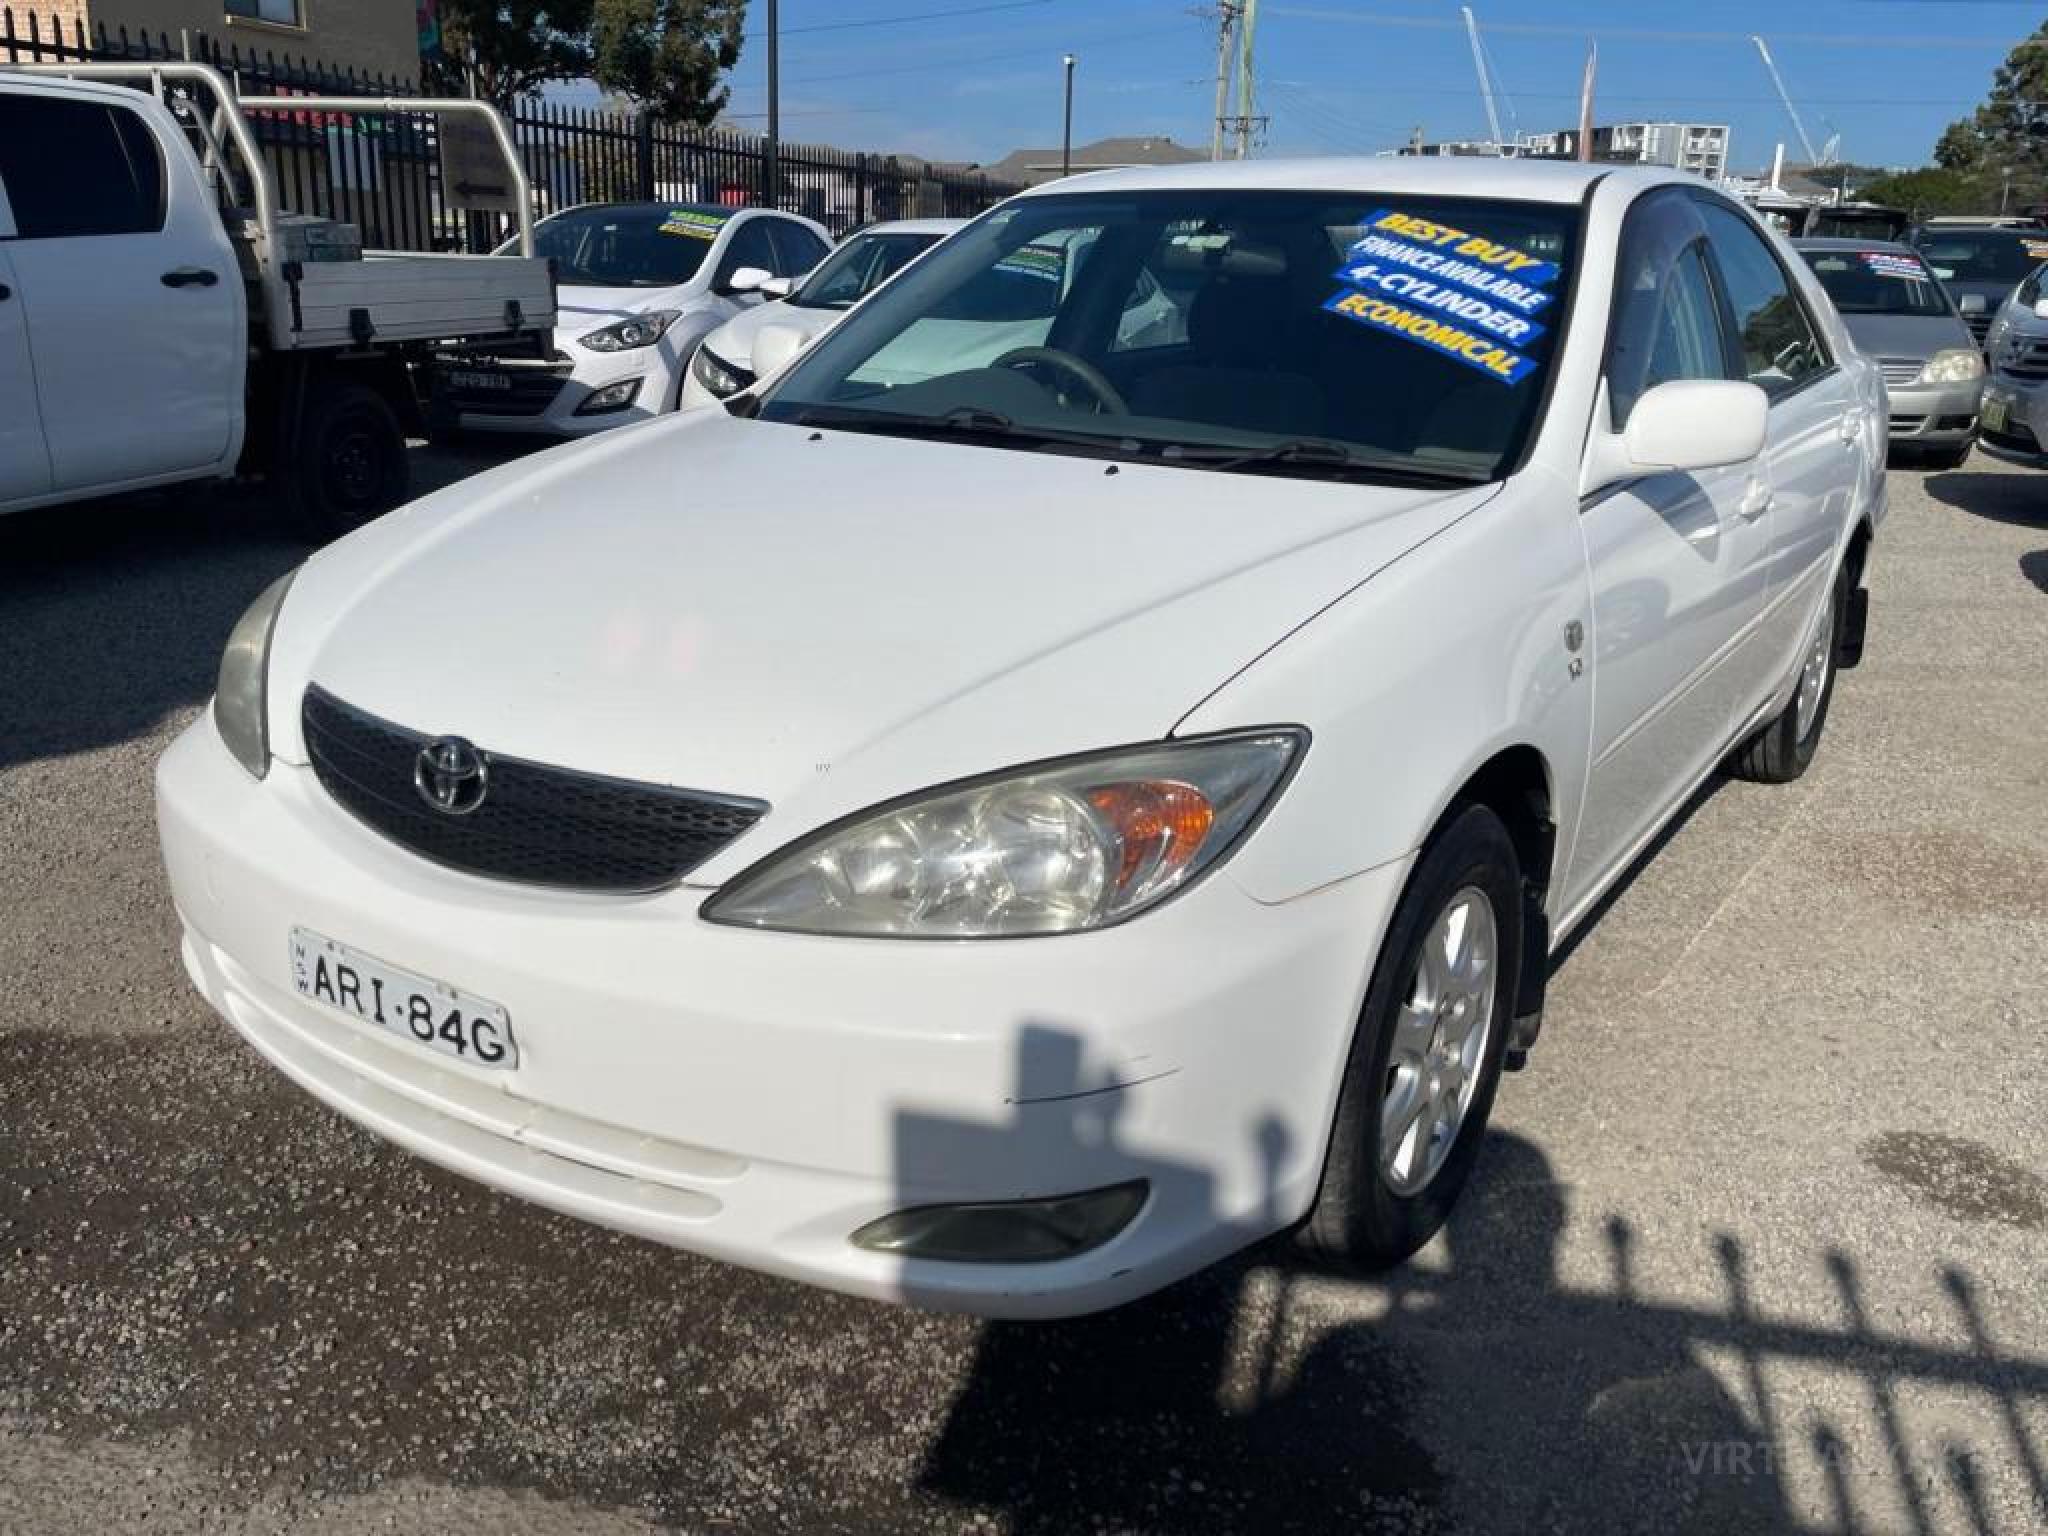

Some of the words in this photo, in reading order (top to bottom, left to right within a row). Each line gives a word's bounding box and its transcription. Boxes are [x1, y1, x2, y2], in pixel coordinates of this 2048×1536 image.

[1353, 235, 1446, 275] FINANCE
[1430, 257, 1548, 310] AVAILABLE
[1375, 213, 1467, 245] BEST
[1455, 238, 1543, 271] BUY
[1335, 293, 1521, 375] ECONOMICAL
[1349, 265, 1531, 339] 4-CYLINDER
